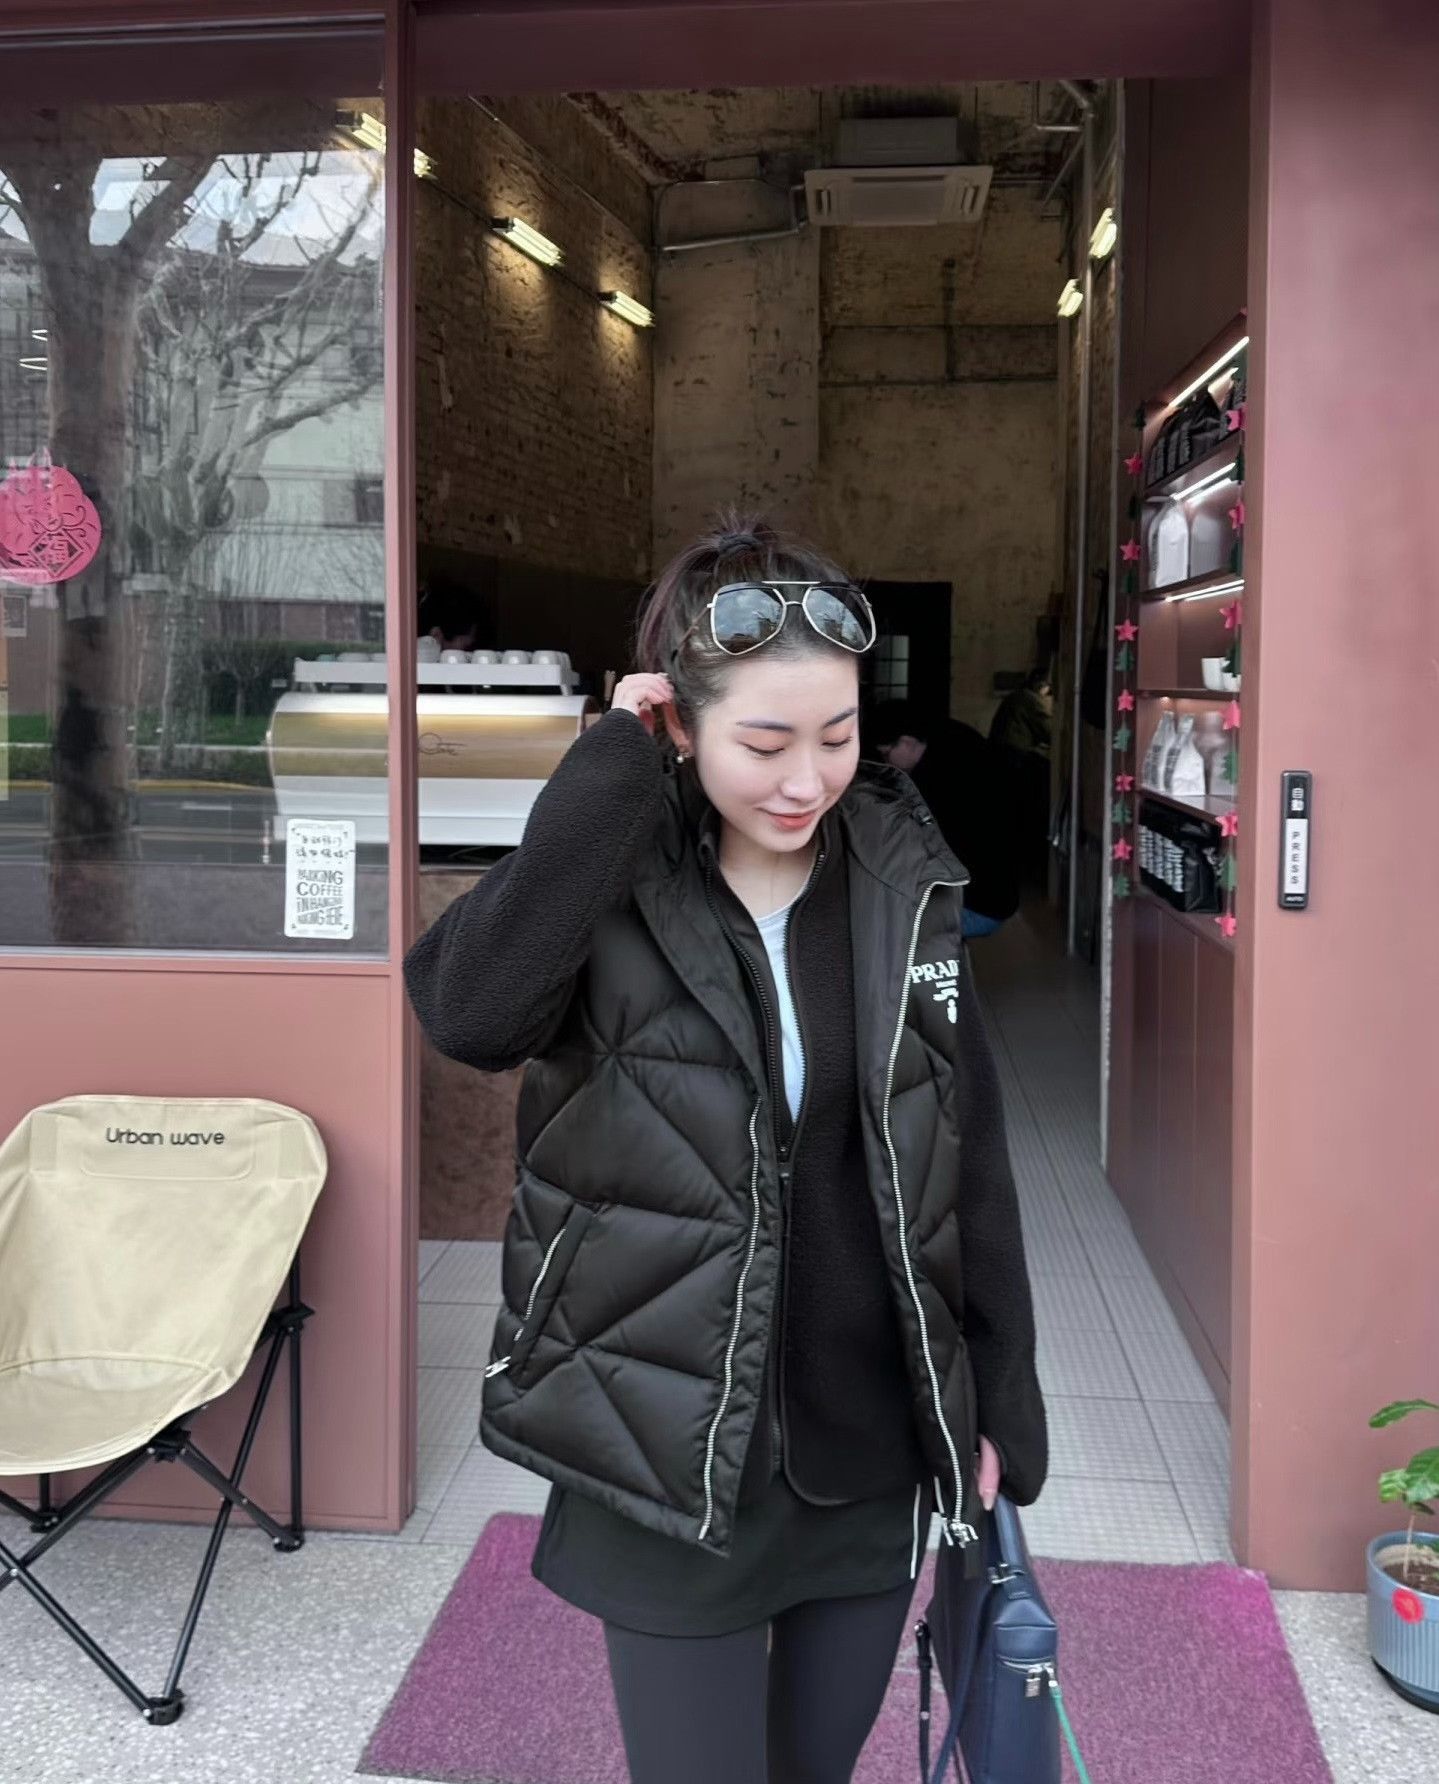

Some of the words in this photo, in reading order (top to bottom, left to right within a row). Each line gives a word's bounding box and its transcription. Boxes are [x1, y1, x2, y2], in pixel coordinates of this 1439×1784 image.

[1291, 831, 1300, 885] PRESS
[910, 959, 960, 983] PRAD
[105, 1127, 163, 1145] Urban
[170, 1132, 224, 1145] wave
